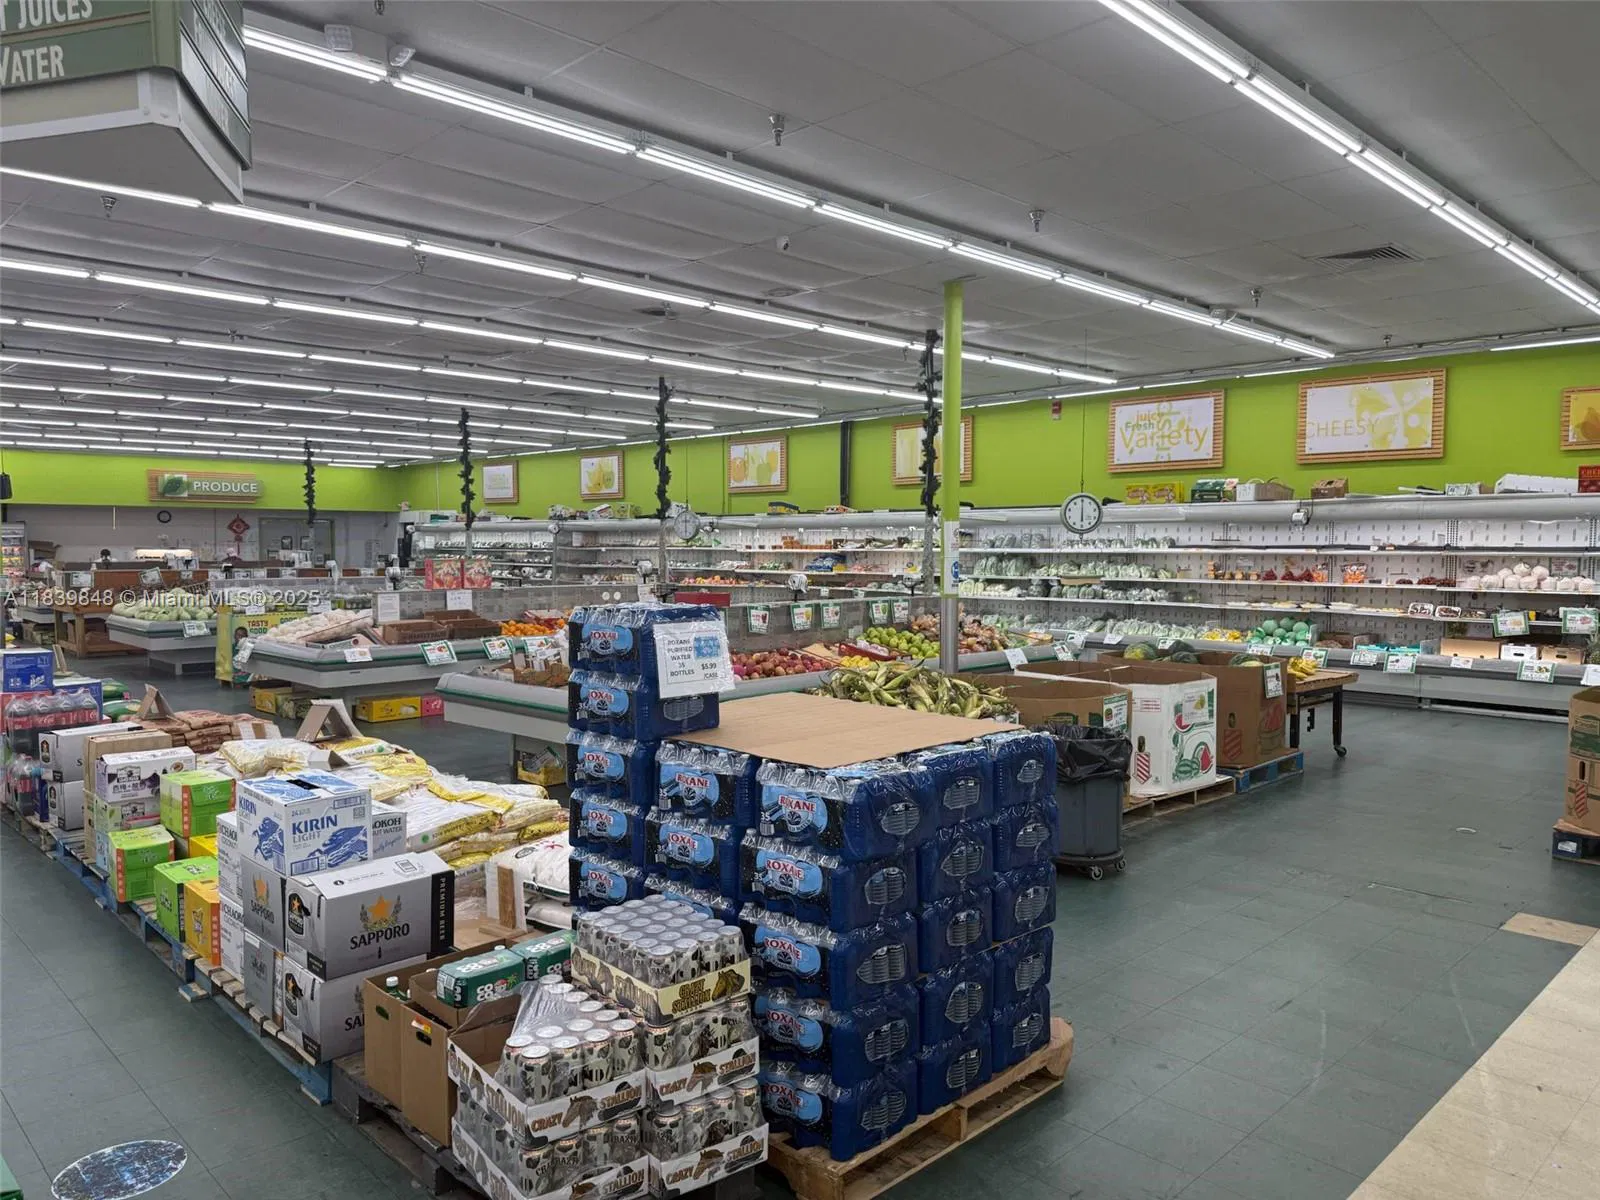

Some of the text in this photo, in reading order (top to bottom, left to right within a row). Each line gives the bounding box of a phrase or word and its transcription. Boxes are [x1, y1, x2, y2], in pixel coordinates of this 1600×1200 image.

[1119, 422, 1209, 452] Variety
[1307, 418, 1380, 438] CHEESY
[193, 481, 257, 493] PRODUCE
[670, 653, 691, 661] WATER
[670, 669, 695, 677] BOTTLES
[238, 796, 257, 816] KIRIN
[761, 812, 771, 821] 35
[292, 814, 338, 835] KIRIN
[293, 831, 322, 844] LIGHT
[250, 899, 275, 925] SAPPORO
[350, 922, 411, 950] SAPPORO
[679, 978, 705, 999] CRAZY
[672, 988, 712, 1013] STALLION
[659, 1051, 757, 1097] CRAZY STALLION
[531, 1084, 643, 1133] CRAZY STALLION
[665, 1139, 765, 1185] CRAZY STALLION
[603, 1168, 645, 1196] STALLION
